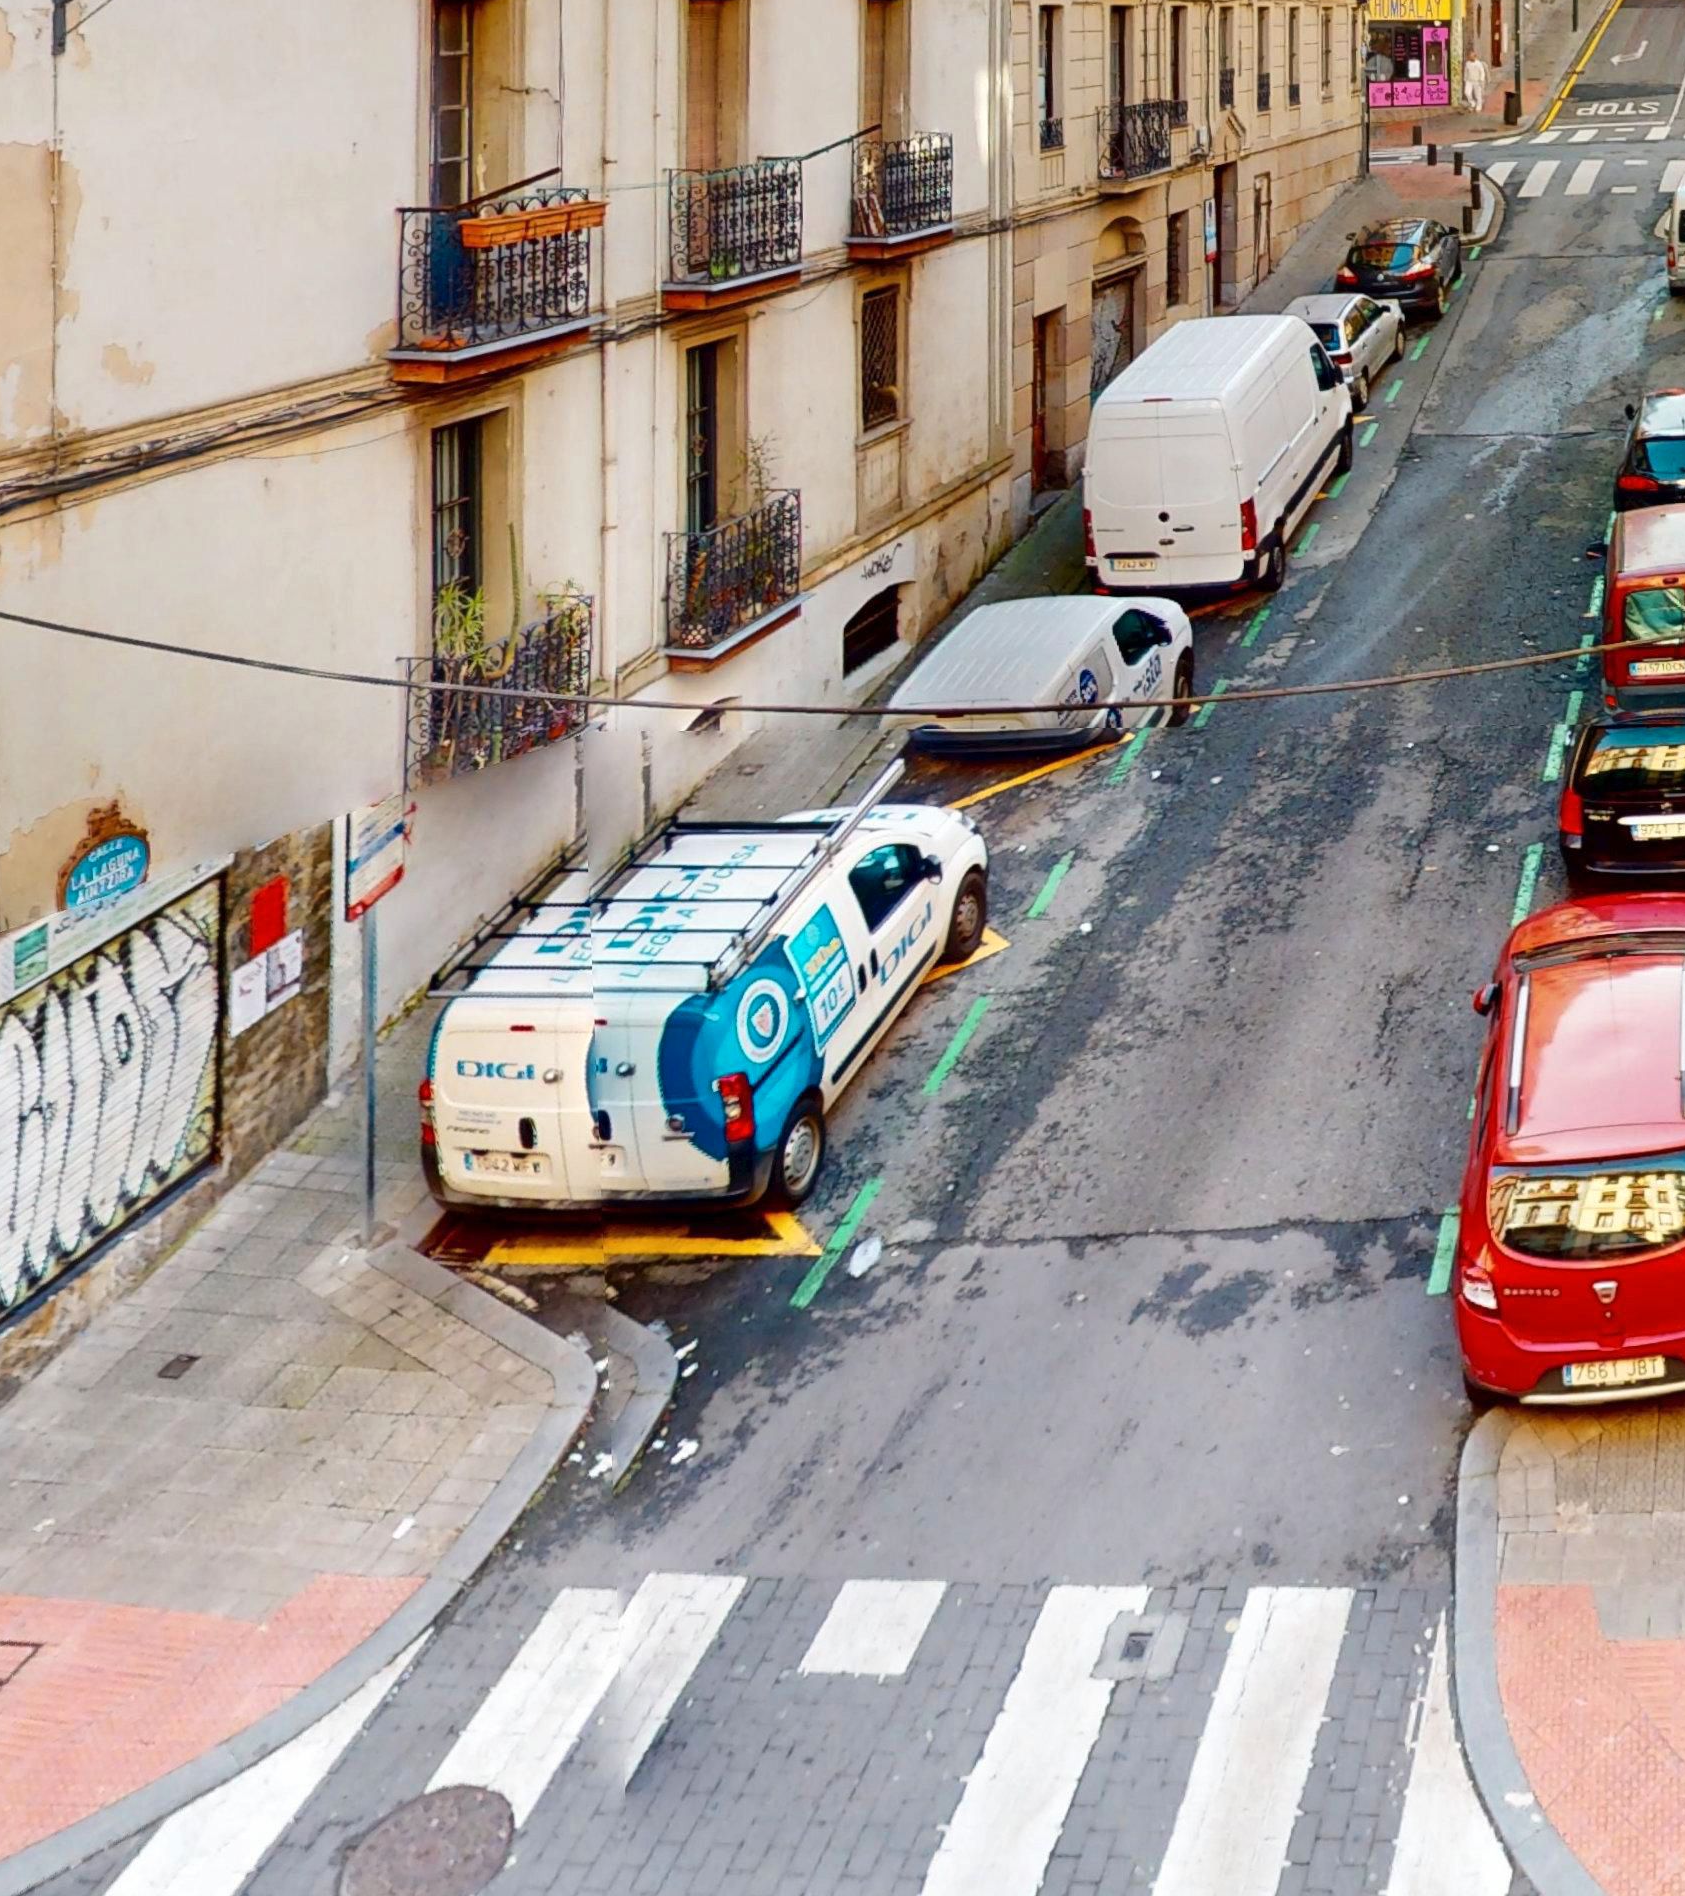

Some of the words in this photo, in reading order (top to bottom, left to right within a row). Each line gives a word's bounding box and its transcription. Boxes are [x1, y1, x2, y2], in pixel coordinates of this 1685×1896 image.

[1576, 102, 1661, 116] STOP
[89, 839, 124, 863] CALLE
[71, 872, 87, 892] LA
[92, 847, 142, 880] LAGUNA
[878, 901, 934, 987] DIGI
[457, 1060, 535, 1080] DIGI
[1628, 1358, 1658, 1377] JBT
